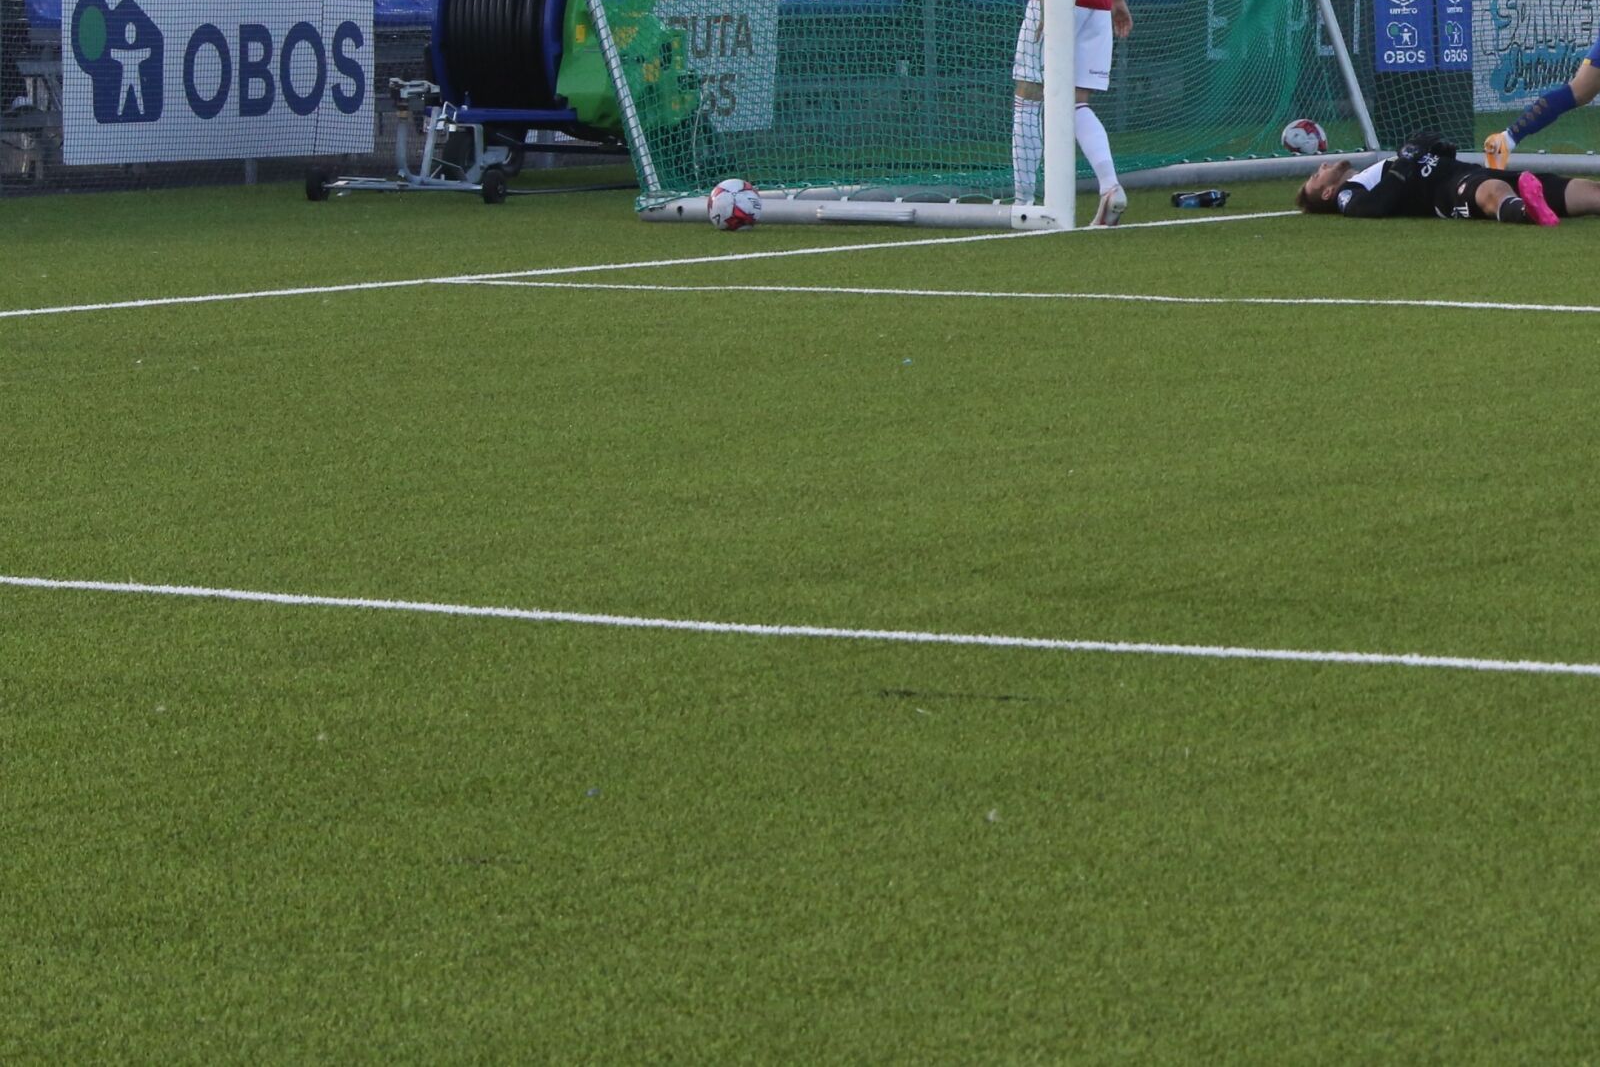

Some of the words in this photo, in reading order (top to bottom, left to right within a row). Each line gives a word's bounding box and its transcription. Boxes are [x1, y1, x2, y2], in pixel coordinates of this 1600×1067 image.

[1384, 51, 1426, 64] OBOS
[1444, 50, 1468, 62] OBOS
[183, 21, 366, 120] OBOS
